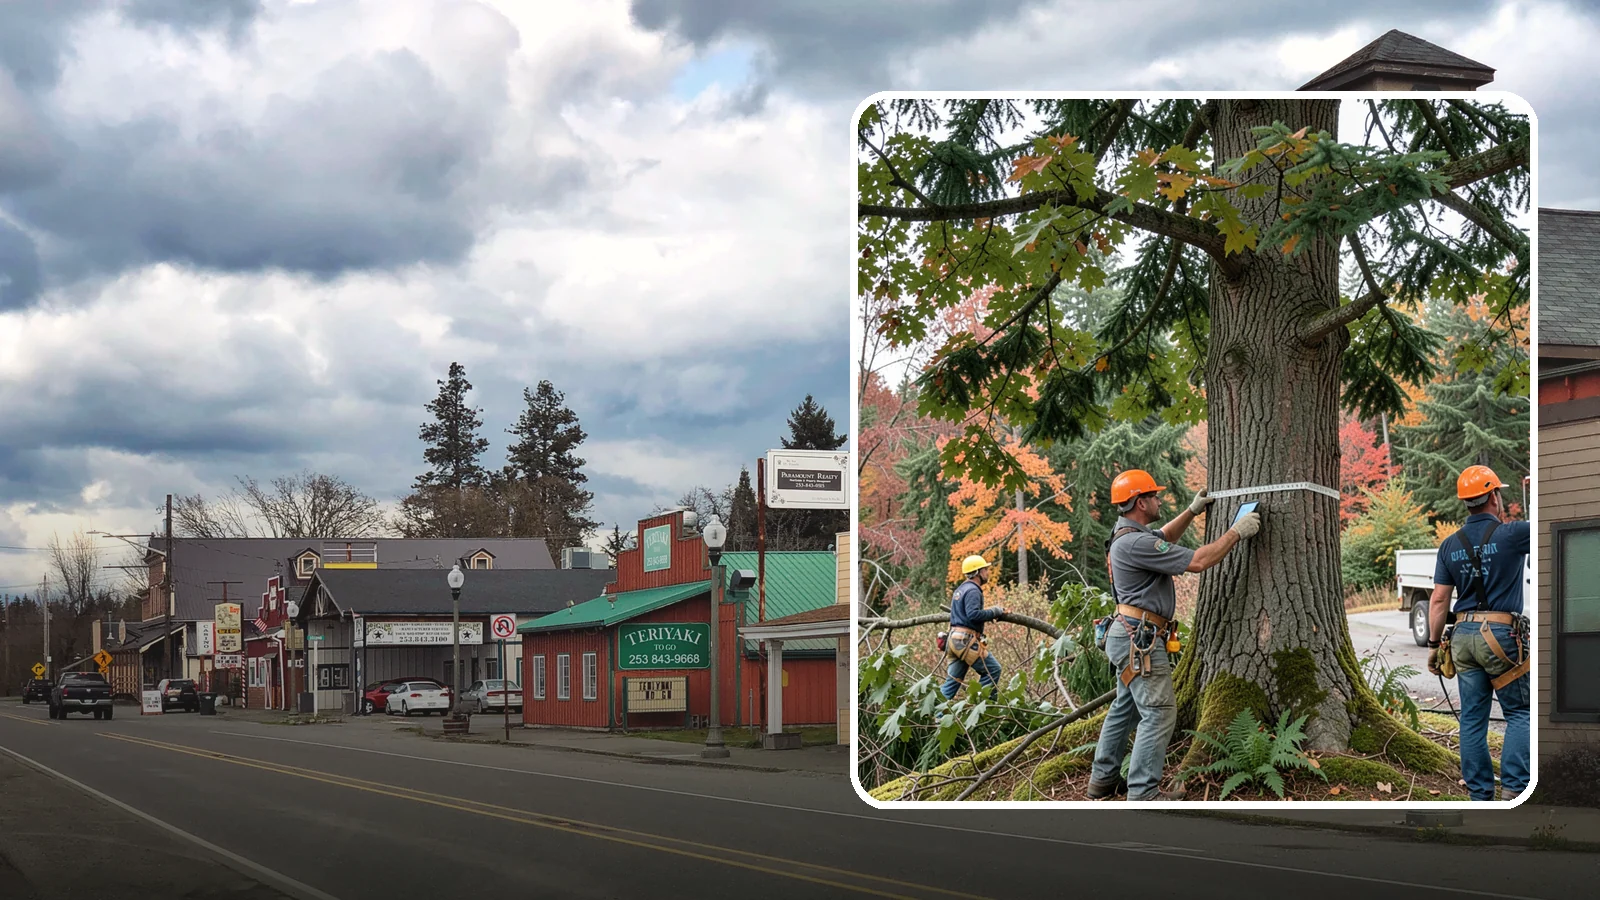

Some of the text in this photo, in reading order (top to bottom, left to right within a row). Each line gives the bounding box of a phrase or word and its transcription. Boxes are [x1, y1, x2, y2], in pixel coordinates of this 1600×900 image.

[781, 471, 839, 480] PARAMOUNT REALTY
[625, 627, 702, 645] TERIYAKI
[629, 654, 700, 664] 253 843-9668
